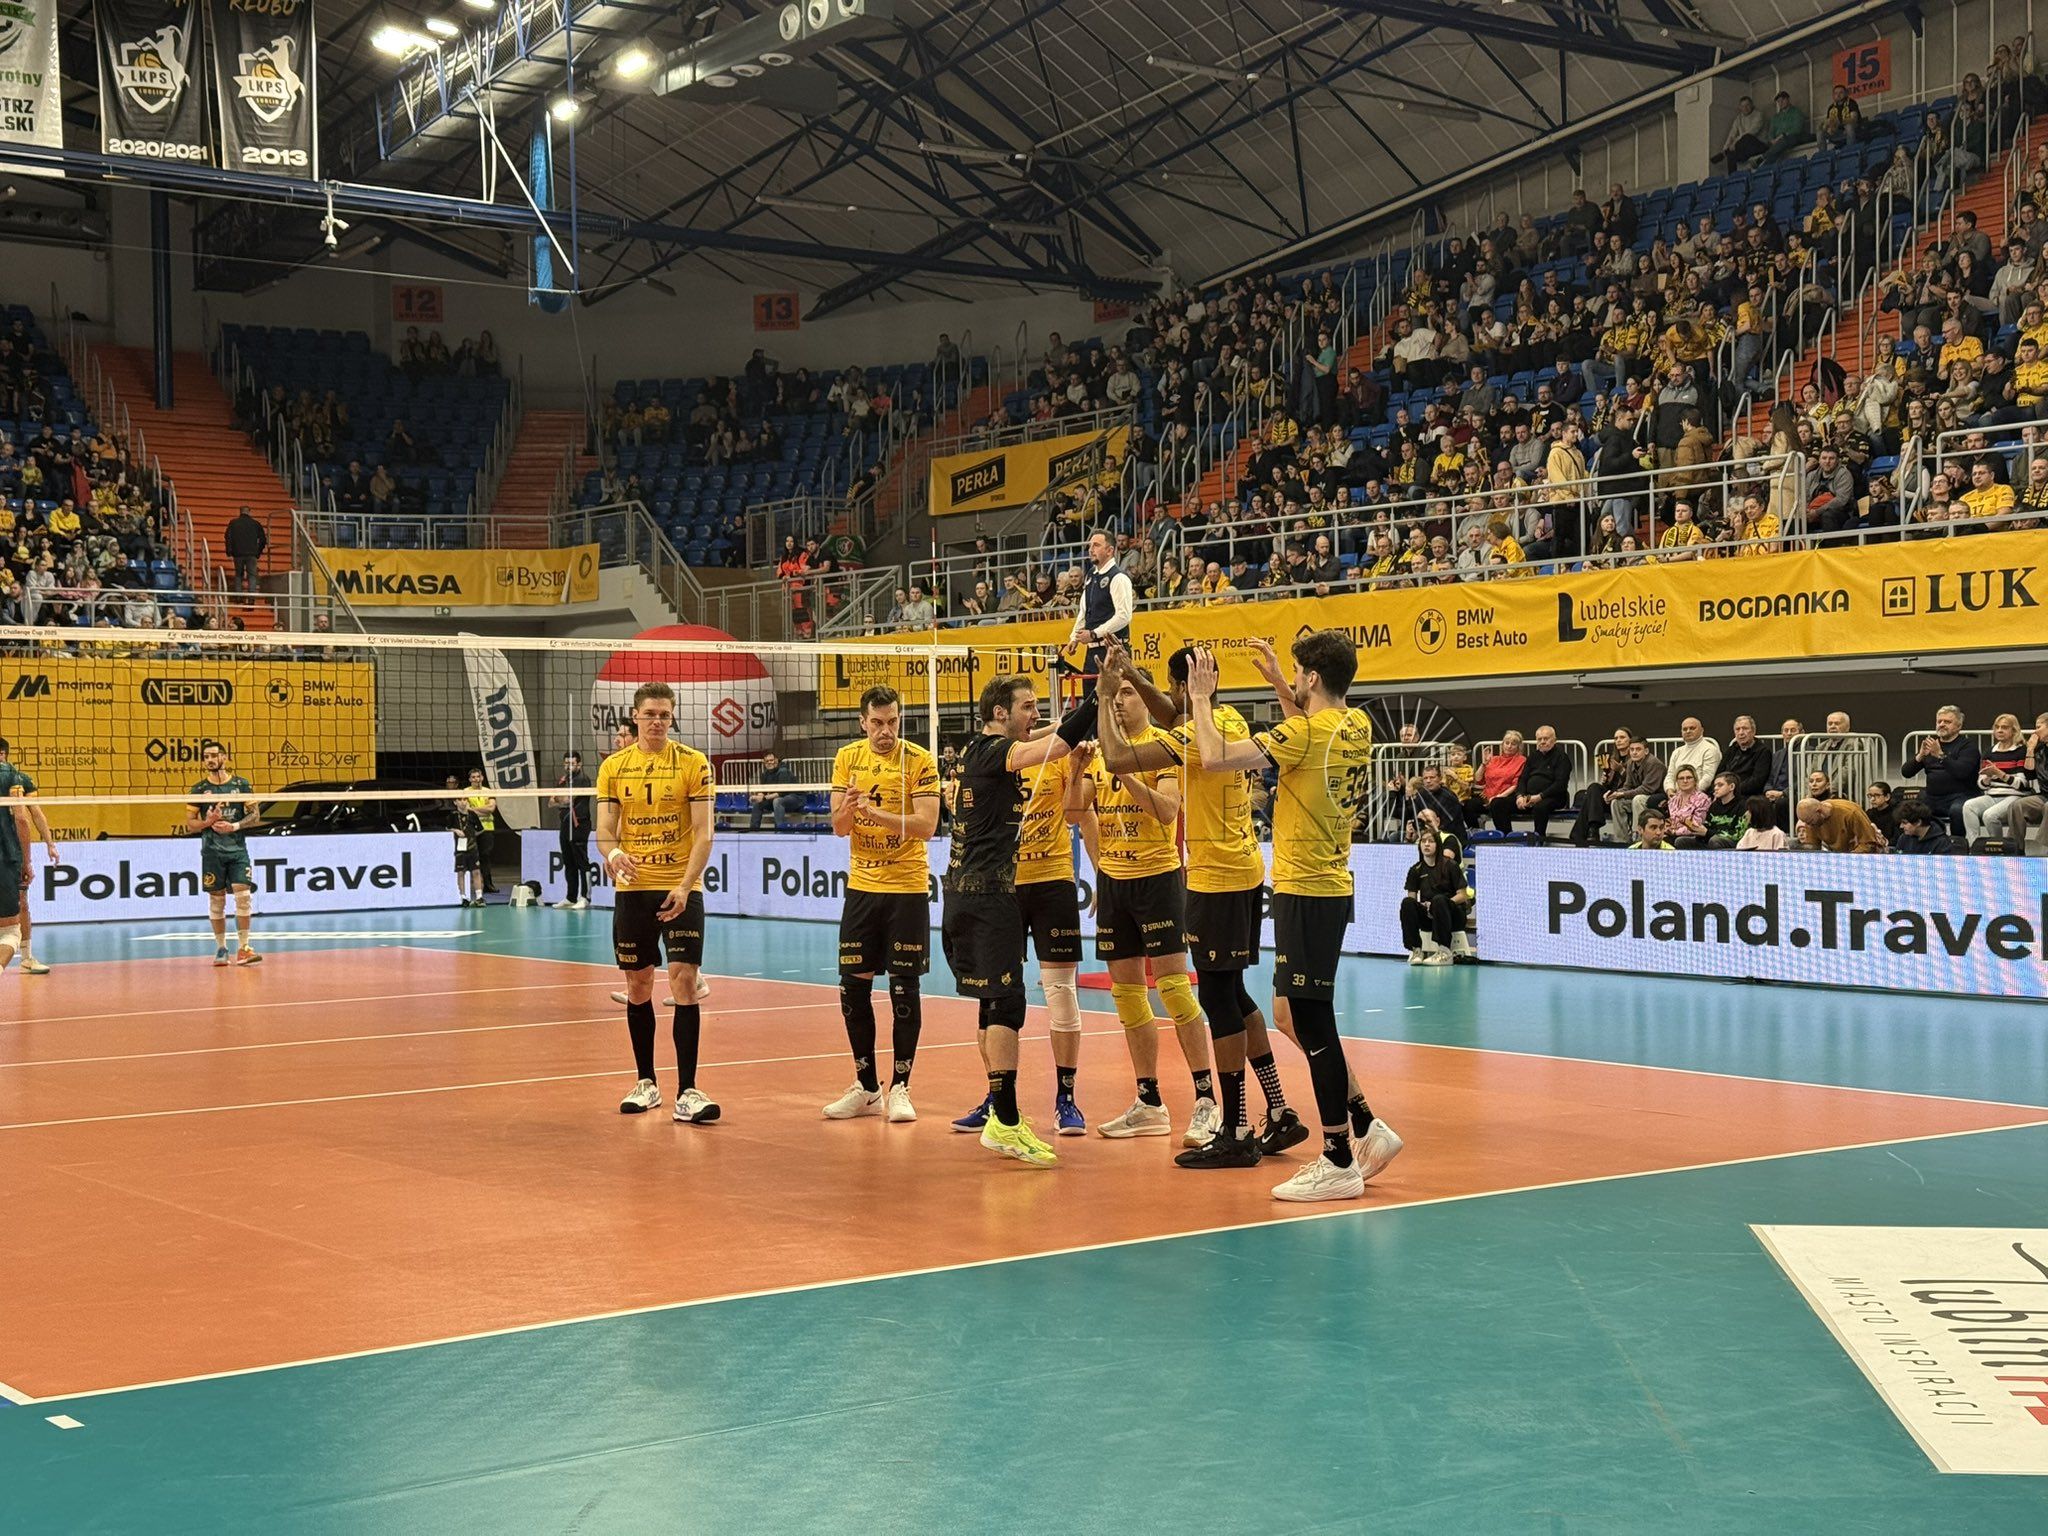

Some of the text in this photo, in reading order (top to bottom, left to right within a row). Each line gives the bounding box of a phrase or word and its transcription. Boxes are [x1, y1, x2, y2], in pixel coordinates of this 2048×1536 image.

[1842, 47, 1880, 85] 15
[130, 69, 168, 85] LKPS
[248, 79, 283, 94] LKPS
[0, 97, 34, 115] TRZ
[109, 138, 208, 161] 2020/2021
[242, 147, 308, 166] 2013
[400, 288, 436, 312] 12
[761, 297, 792, 321] 13
[957, 465, 999, 496] PERŁA
[335, 568, 462, 595] MIKASA
[1925, 566, 2040, 614] LUK
[1699, 589, 1849, 622] BOGDANKA
[1457, 607, 1494, 626] BMW
[1221, 636, 1275, 649] Roztze
[1457, 629, 1528, 649] Best Auto
[1591, 620, 1668, 648] Smakuj życie!
[57, 678, 113, 693] majmax
[147, 680, 227, 704] NEPTUN
[303, 680, 335, 691] BMW
[303, 696, 363, 706] Best Auto
[45, 746, 116, 755] POLITECHNIKA
[268, 751, 310, 766] Pizza
[45, 757, 98, 766] LUBELSKA
[645, 783, 653, 806] 1
[869, 784, 883, 807] 4
[44, 851, 412, 901] PolanTravel
[1147, 920, 1174, 932] STALMA
[1209, 950, 1216, 962] 9
[1292, 973, 1305, 986] 33
[1828, 1277, 1993, 1425] MIASTO INSPIRACJI
